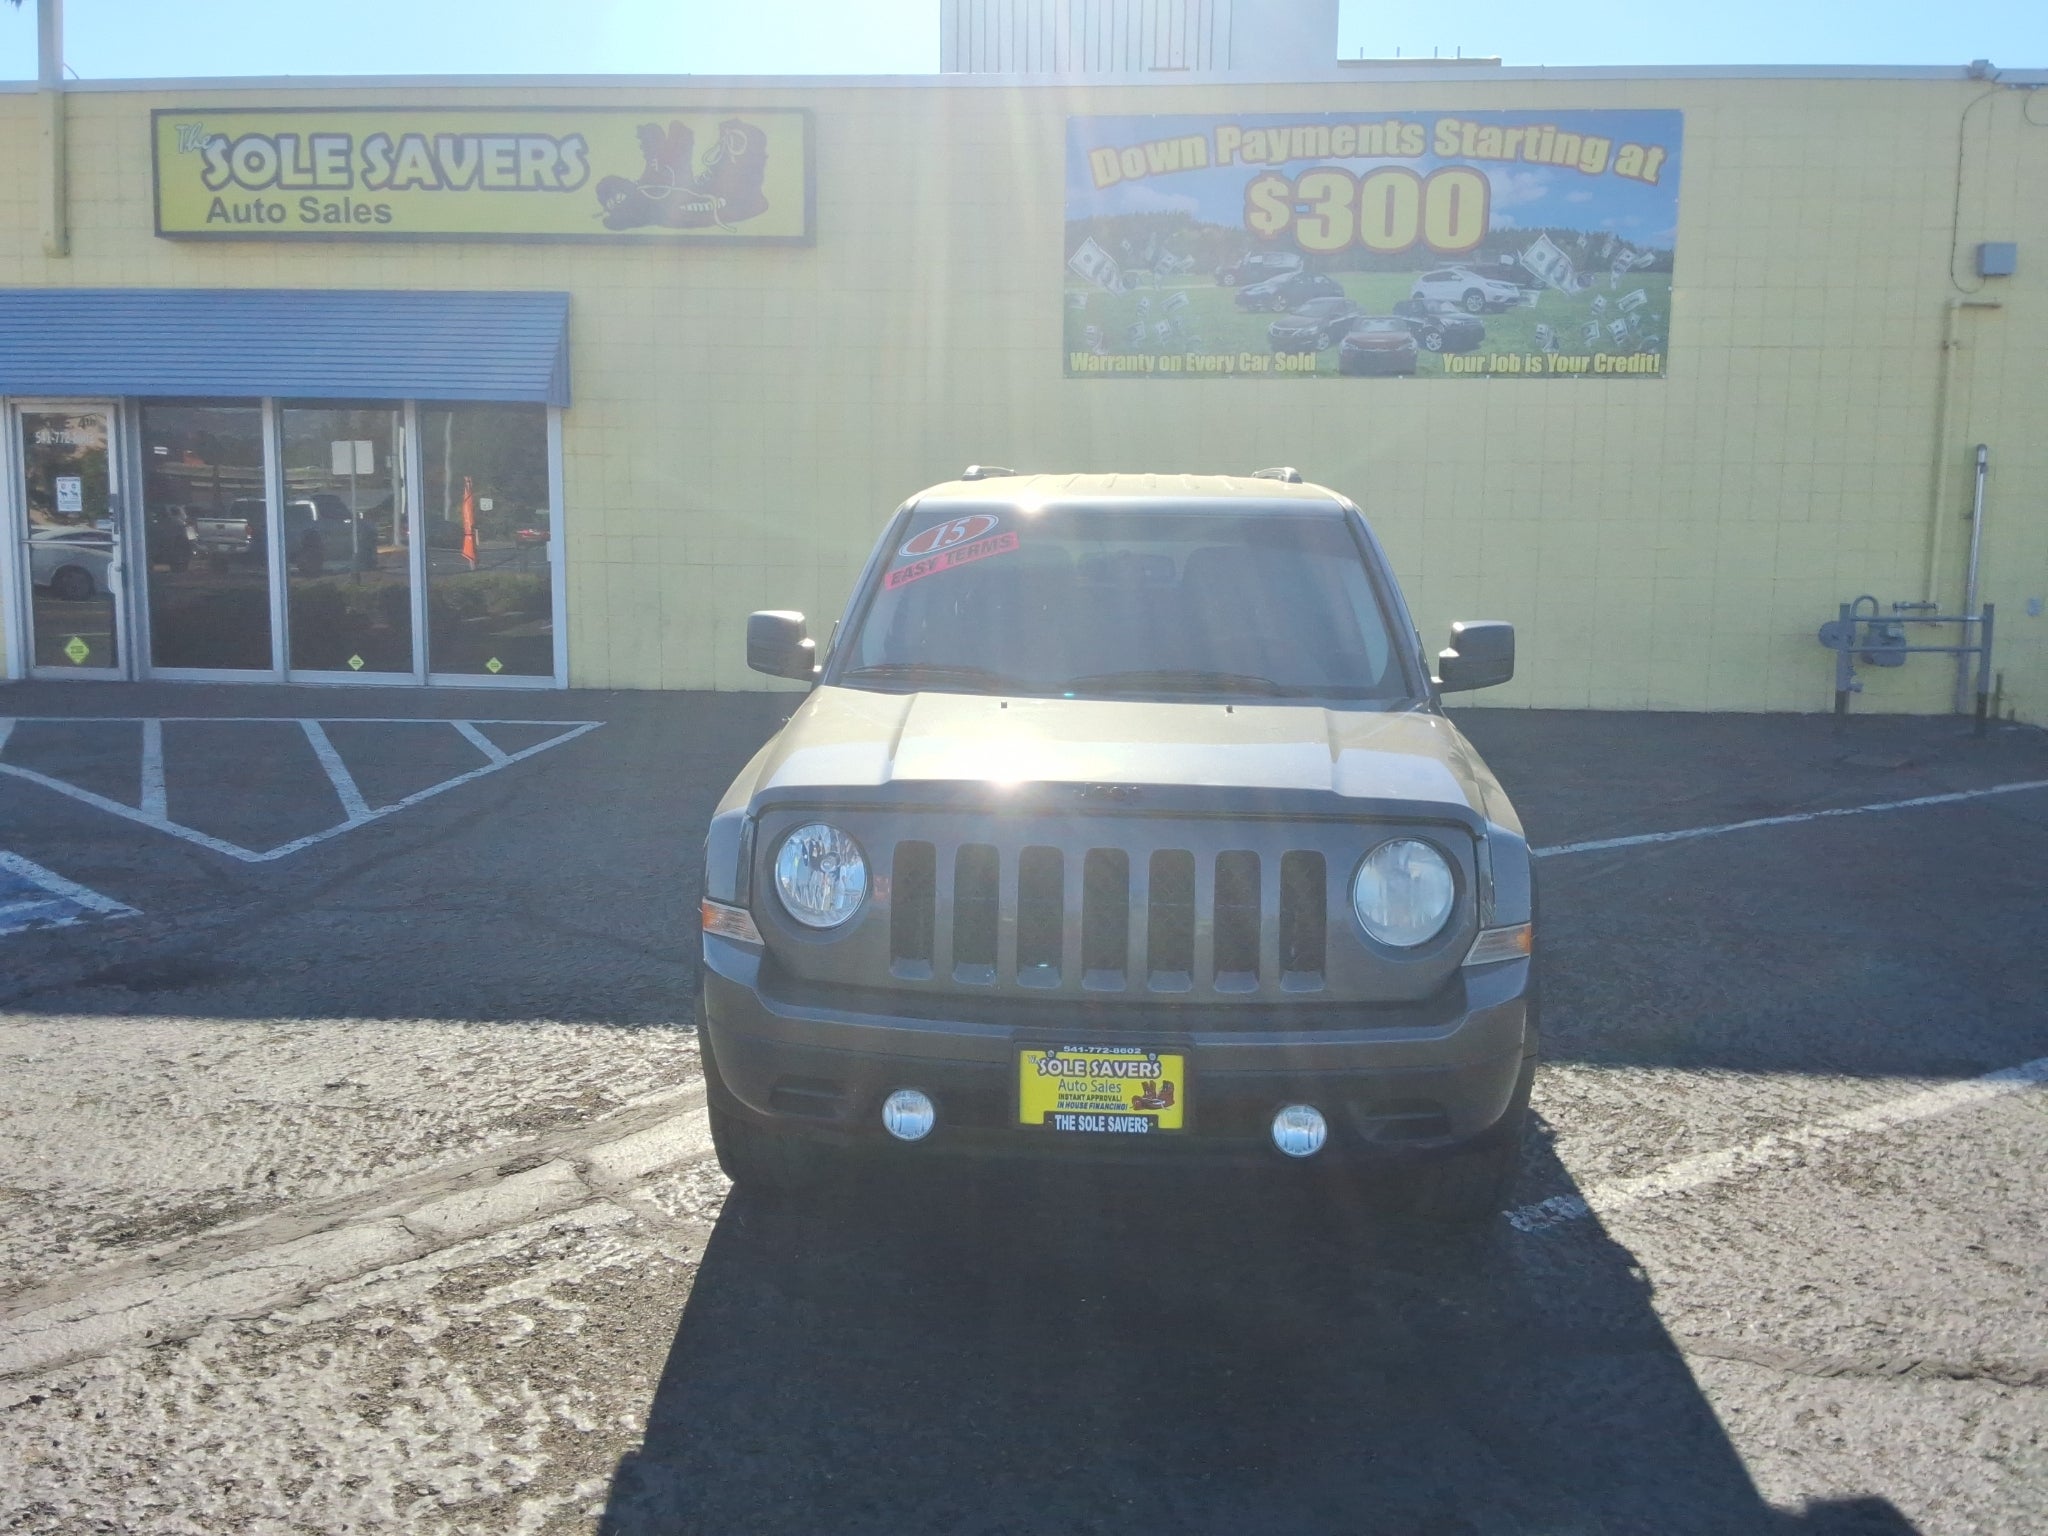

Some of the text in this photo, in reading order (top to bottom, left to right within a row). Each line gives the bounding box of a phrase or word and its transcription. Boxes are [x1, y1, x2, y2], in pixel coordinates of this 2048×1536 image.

[176, 123, 212, 153] The
[201, 132, 591, 192] SOLE SAVERS
[1089, 117, 1667, 190] Down Payments Starting at
[206, 196, 393, 224] Auto Sales
[1245, 168, 1491, 255] $300
[1070, 352, 1317, 374] Warranty on Every Car Sold
[1443, 353, 1661, 374] Your Job is Your Credit!
[927, 519, 972, 551] 15
[890, 534, 1014, 587] EASY TERMS
[1038, 1058, 1087, 1077] SOLE
[1090, 1059, 1161, 1078] SAVERS
[1058, 1078, 1122, 1093] Auto Sales
[1055, 1114, 1149, 1133] THE SOLE SAVERS
